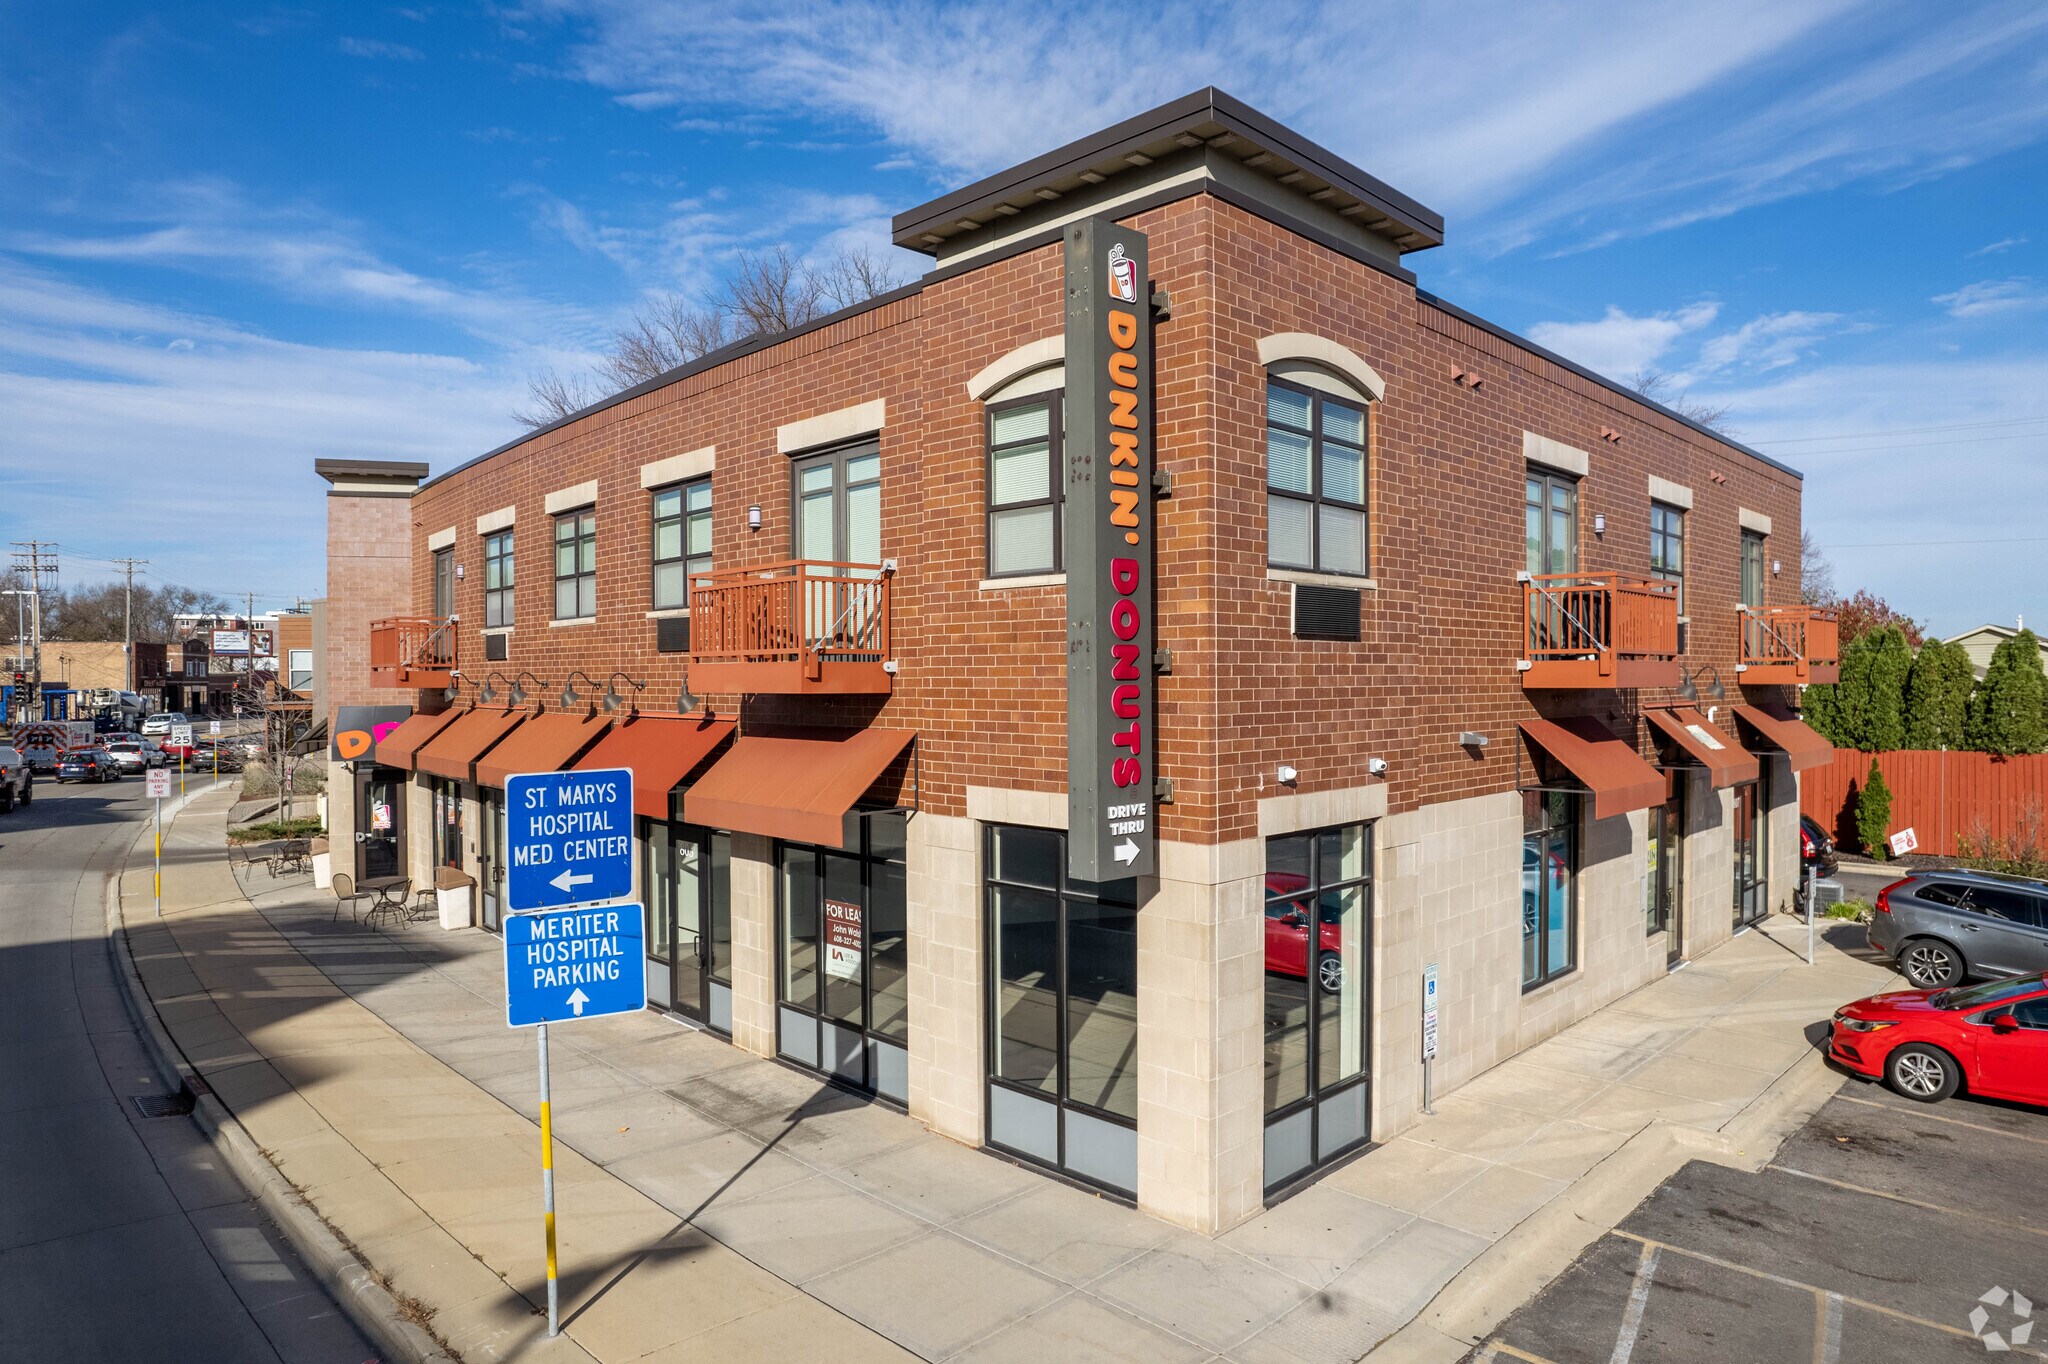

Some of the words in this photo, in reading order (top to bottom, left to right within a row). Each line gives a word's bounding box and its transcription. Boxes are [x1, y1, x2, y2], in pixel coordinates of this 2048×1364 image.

[1108, 310, 1140, 545] DUNKIN'
[1110, 558, 1141, 788] DONUTS
[174, 736, 190, 744] 25
[558, 783, 617, 806] MARYS
[530, 810, 613, 837] HOSPITAL
[1107, 803, 1146, 819] DRIVE
[1109, 820, 1145, 836] THRU
[563, 836, 628, 862] CENTER
[530, 912, 619, 941] MERITER
[826, 904, 843, 919] FOR
[844, 907, 861, 923] LEA
[833, 924, 847, 934] John
[527, 936, 623, 965] HOSPITAL
[533, 960, 620, 989] PARKING
